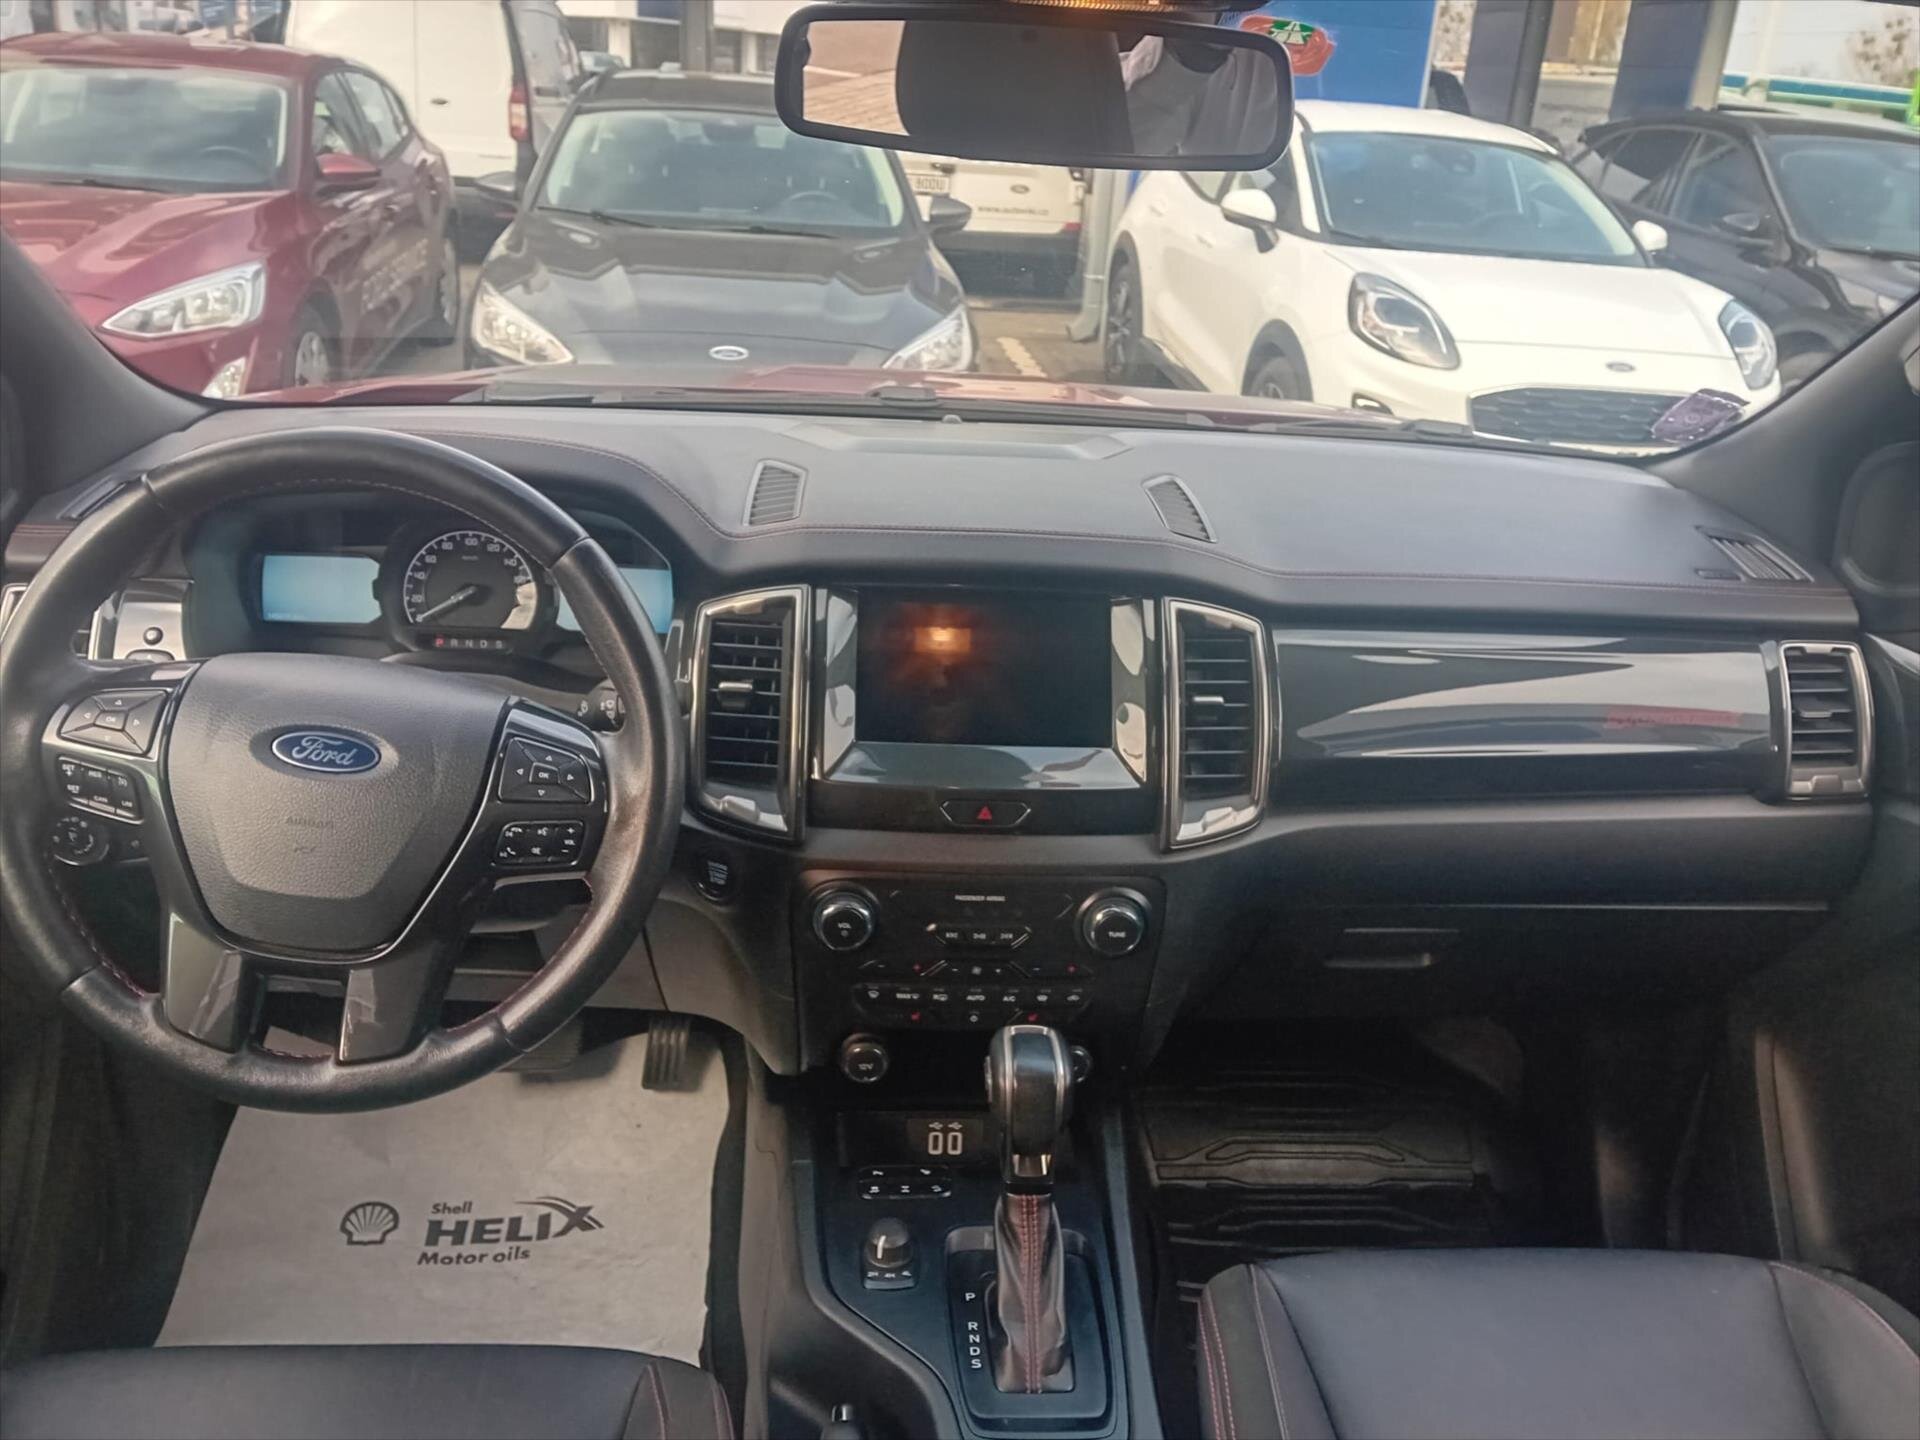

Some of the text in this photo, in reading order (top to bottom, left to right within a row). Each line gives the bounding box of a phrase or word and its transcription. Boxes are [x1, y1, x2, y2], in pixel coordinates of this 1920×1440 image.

[435, 638, 444, 647] P
[465, 639, 473, 648] N
[480, 640, 487, 648] D
[291, 736, 358, 766] Ford
[1108, 931, 1126, 939] TUNE
[431, 1202, 473, 1215] Shell
[424, 1197, 605, 1247] HELIX
[417, 1246, 531, 1266] Motor oils
[965, 1292, 976, 1301] P
[968, 1321, 978, 1331] R
[969, 1334, 980, 1343] N
[970, 1346, 981, 1356] D
[971, 1359, 982, 1369] S
